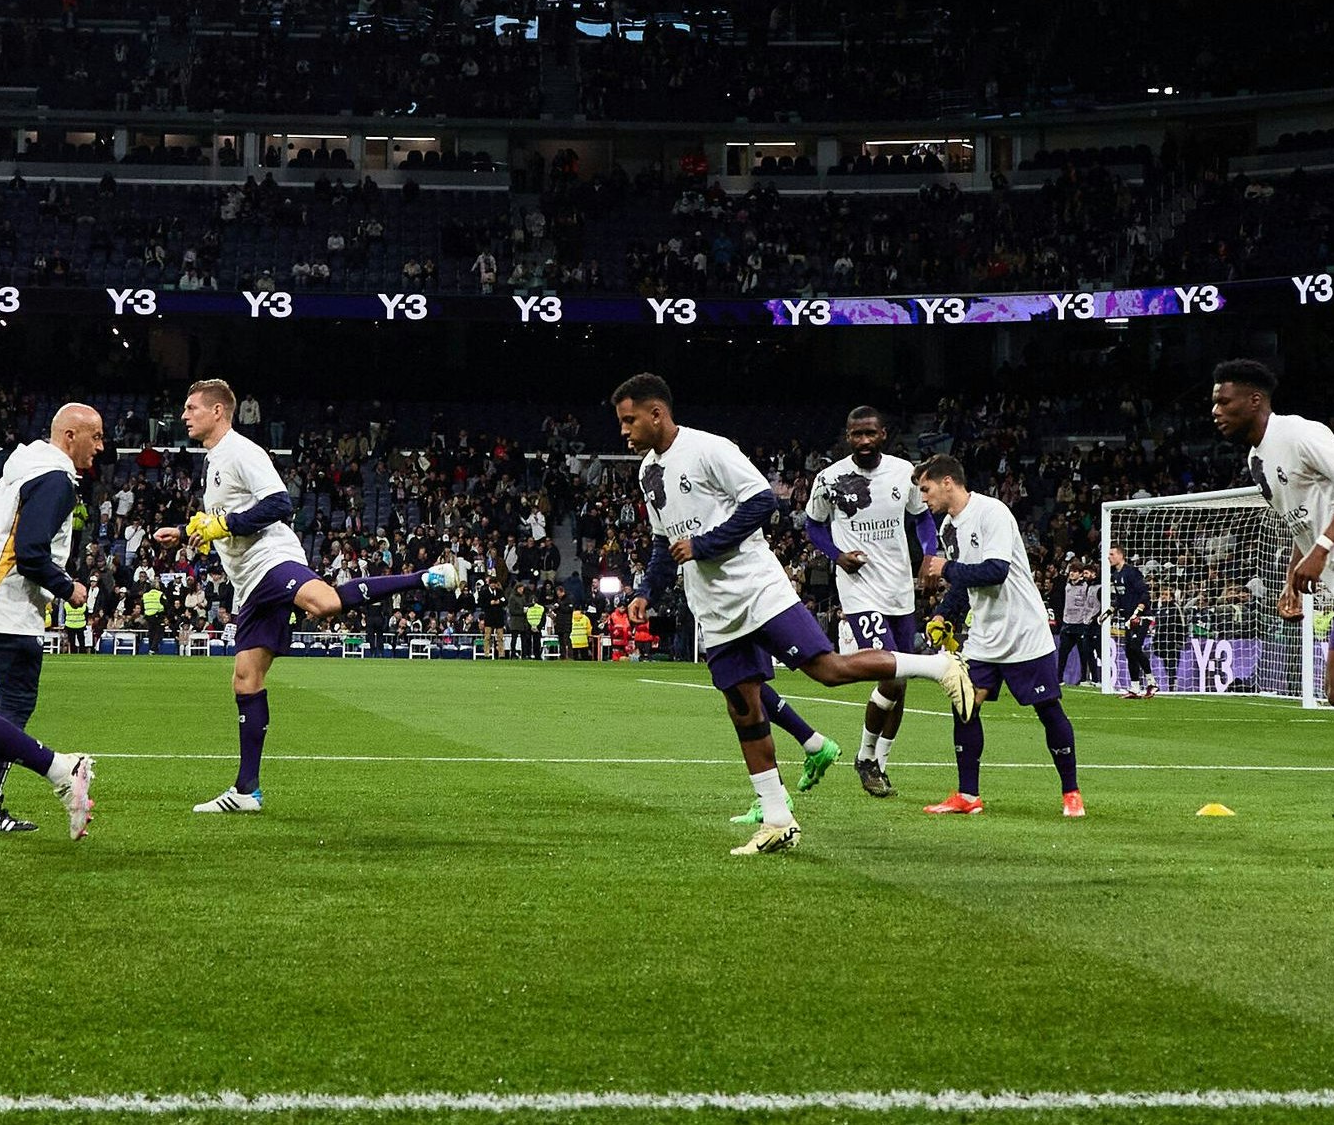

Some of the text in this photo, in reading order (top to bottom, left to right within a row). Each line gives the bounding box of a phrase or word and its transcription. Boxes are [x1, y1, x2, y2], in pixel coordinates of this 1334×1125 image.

[107, 289, 156, 314] Y-3
[1175, 286, 1218, 313] Y-3
[1292, 274, 1332, 304] Y-3
[243, 292, 292, 317] Y-3
[378, 294, 427, 319] Y-3
[513, 296, 561, 322] Y-3
[647, 298, 696, 324] Y-3
[783, 300, 830, 325] Y-3
[917, 299, 965, 323] Y-3
[1049, 294, 1094, 319] Y-3
[851, 517, 901, 532] Emirates
[858, 611, 887, 639] 22
[1192, 638, 1234, 694] Y-3
